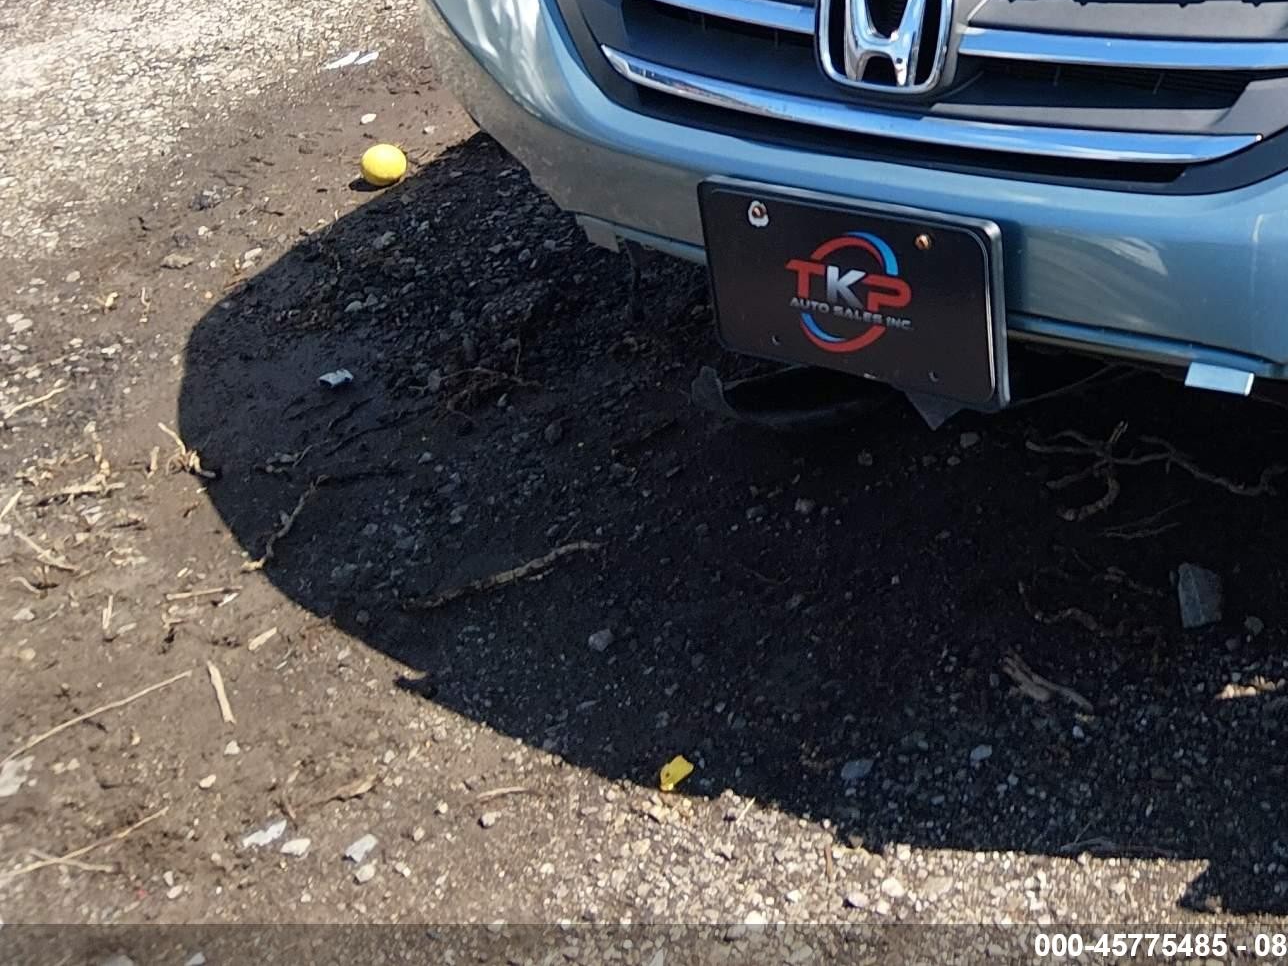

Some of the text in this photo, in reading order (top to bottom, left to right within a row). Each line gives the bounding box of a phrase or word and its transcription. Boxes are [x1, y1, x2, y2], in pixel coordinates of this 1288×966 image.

[785, 259, 912, 312] TKP
[789, 297, 830, 314] AUTO
[833, 305, 884, 325] SALES
